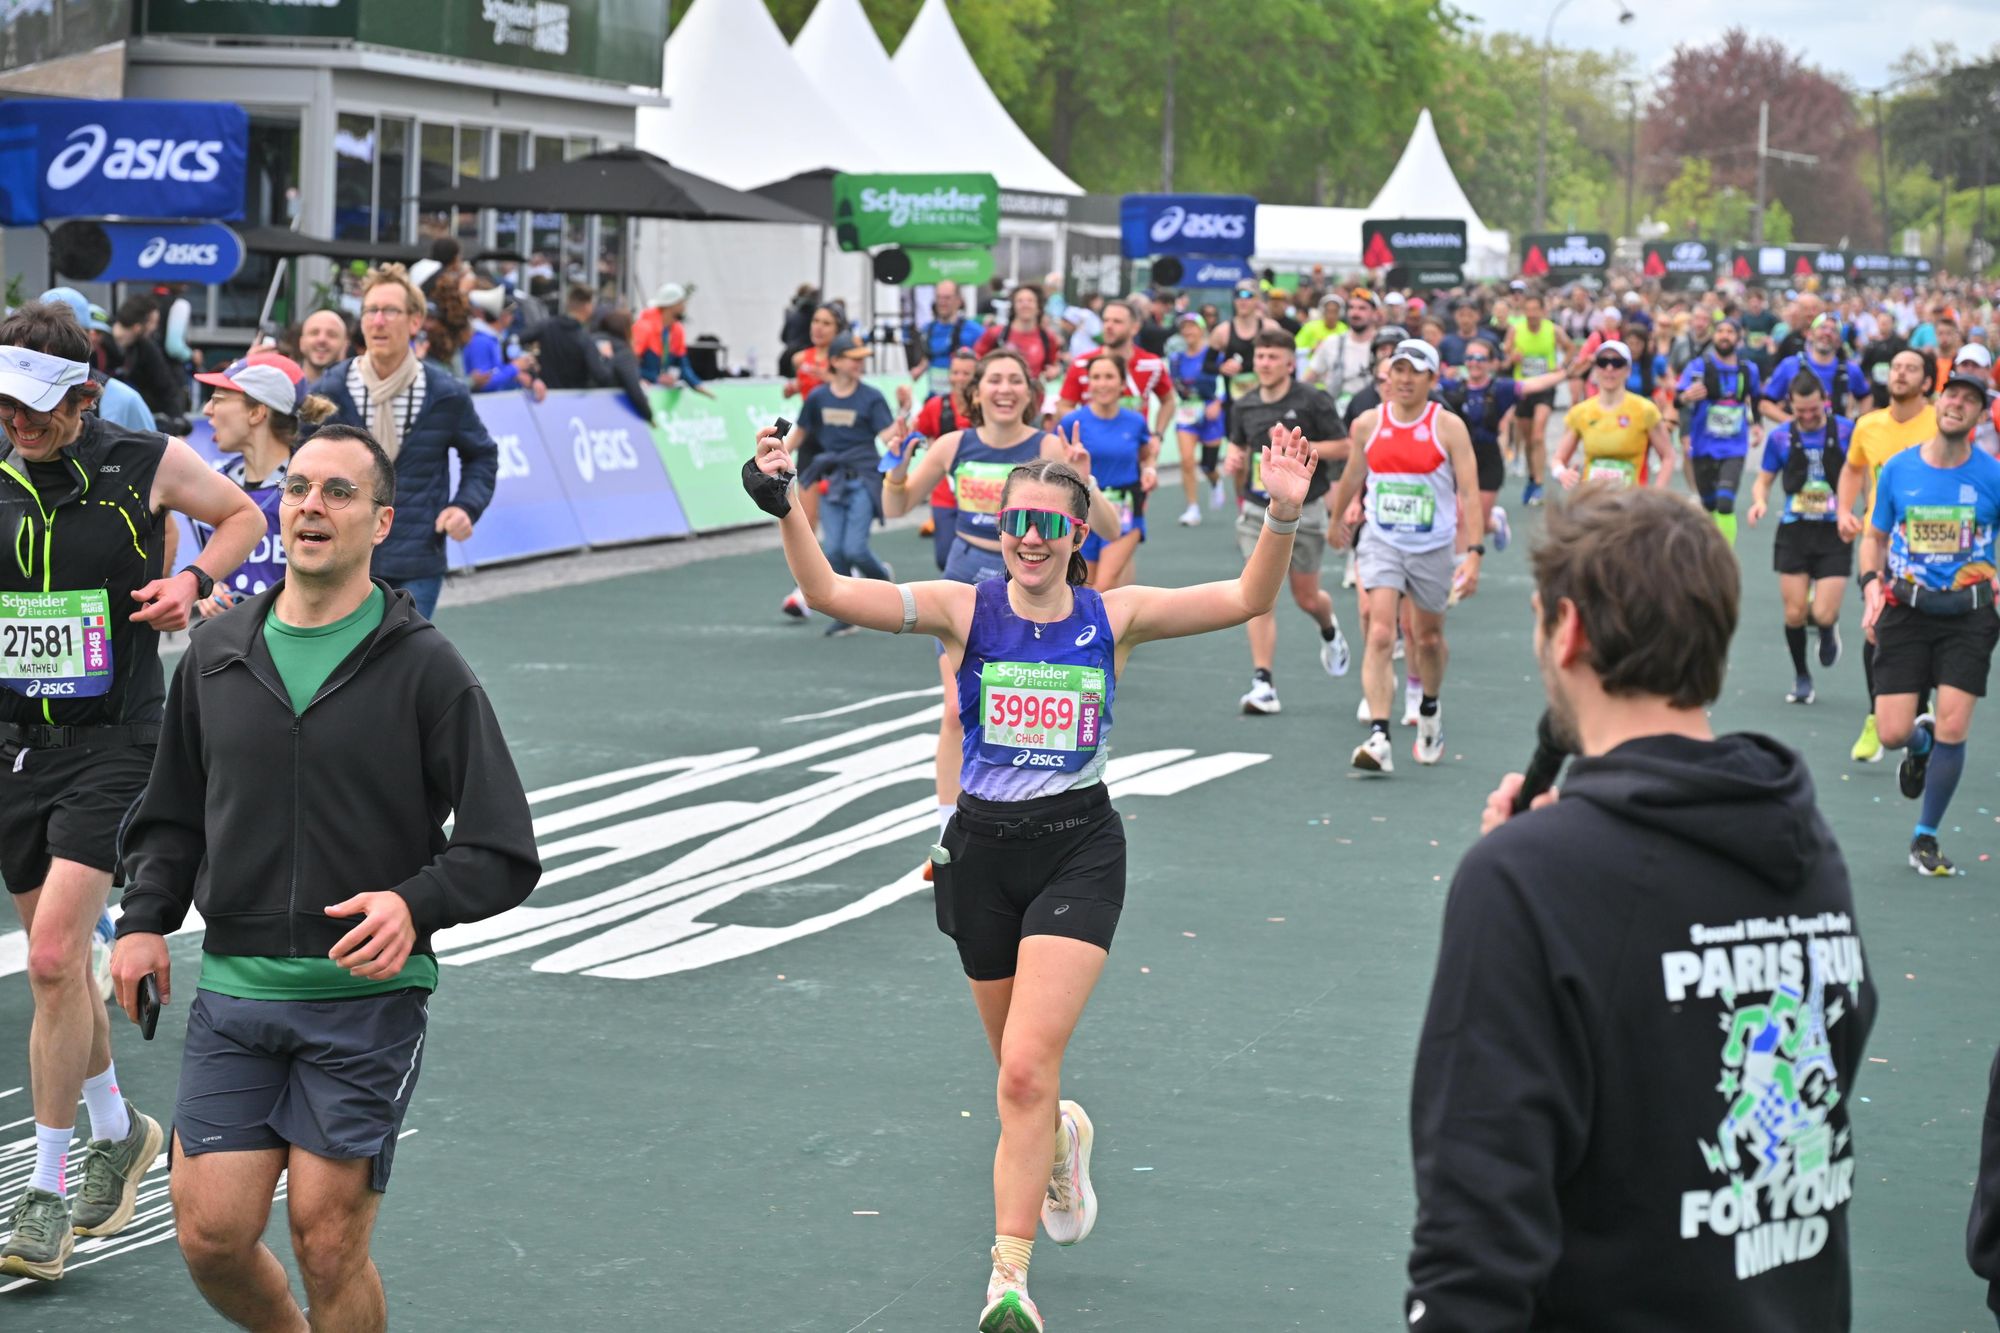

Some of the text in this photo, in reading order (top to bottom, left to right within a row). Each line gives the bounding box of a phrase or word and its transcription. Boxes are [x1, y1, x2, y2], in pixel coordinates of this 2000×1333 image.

[103, 138, 223, 182] asics
[860, 187, 986, 212] Schneider
[1181, 213, 1248, 239] asics
[1391, 232, 1462, 249] GARMIN
[164, 243, 219, 265] asics
[590, 428, 640, 472] asics
[100, 465, 121, 473] asics
[1913, 523, 1956, 542] 33554
[1, 594, 68, 608] Schneider
[28, 607, 67, 616] Electric
[4, 625, 73, 658] 27581
[89, 632, 103, 667] 3H45
[20, 663, 58, 673] MATHYEU
[996, 664, 1070, 680] Schneider
[41, 682, 75, 695] asics
[1027, 678, 1068, 688] Electric
[990, 693, 1074, 731] 39969
[1082, 707, 1095, 743] 3H45
[1016, 733, 1045, 744] CHLOE
[1030, 753, 1065, 767] asics
[1690, 920, 1745, 945] Sound
[1662, 936, 1864, 1002] PARIS RUN
[1680, 1156, 1855, 1239] FOR YOUR
[1735, 1215, 1830, 1280] MIND
